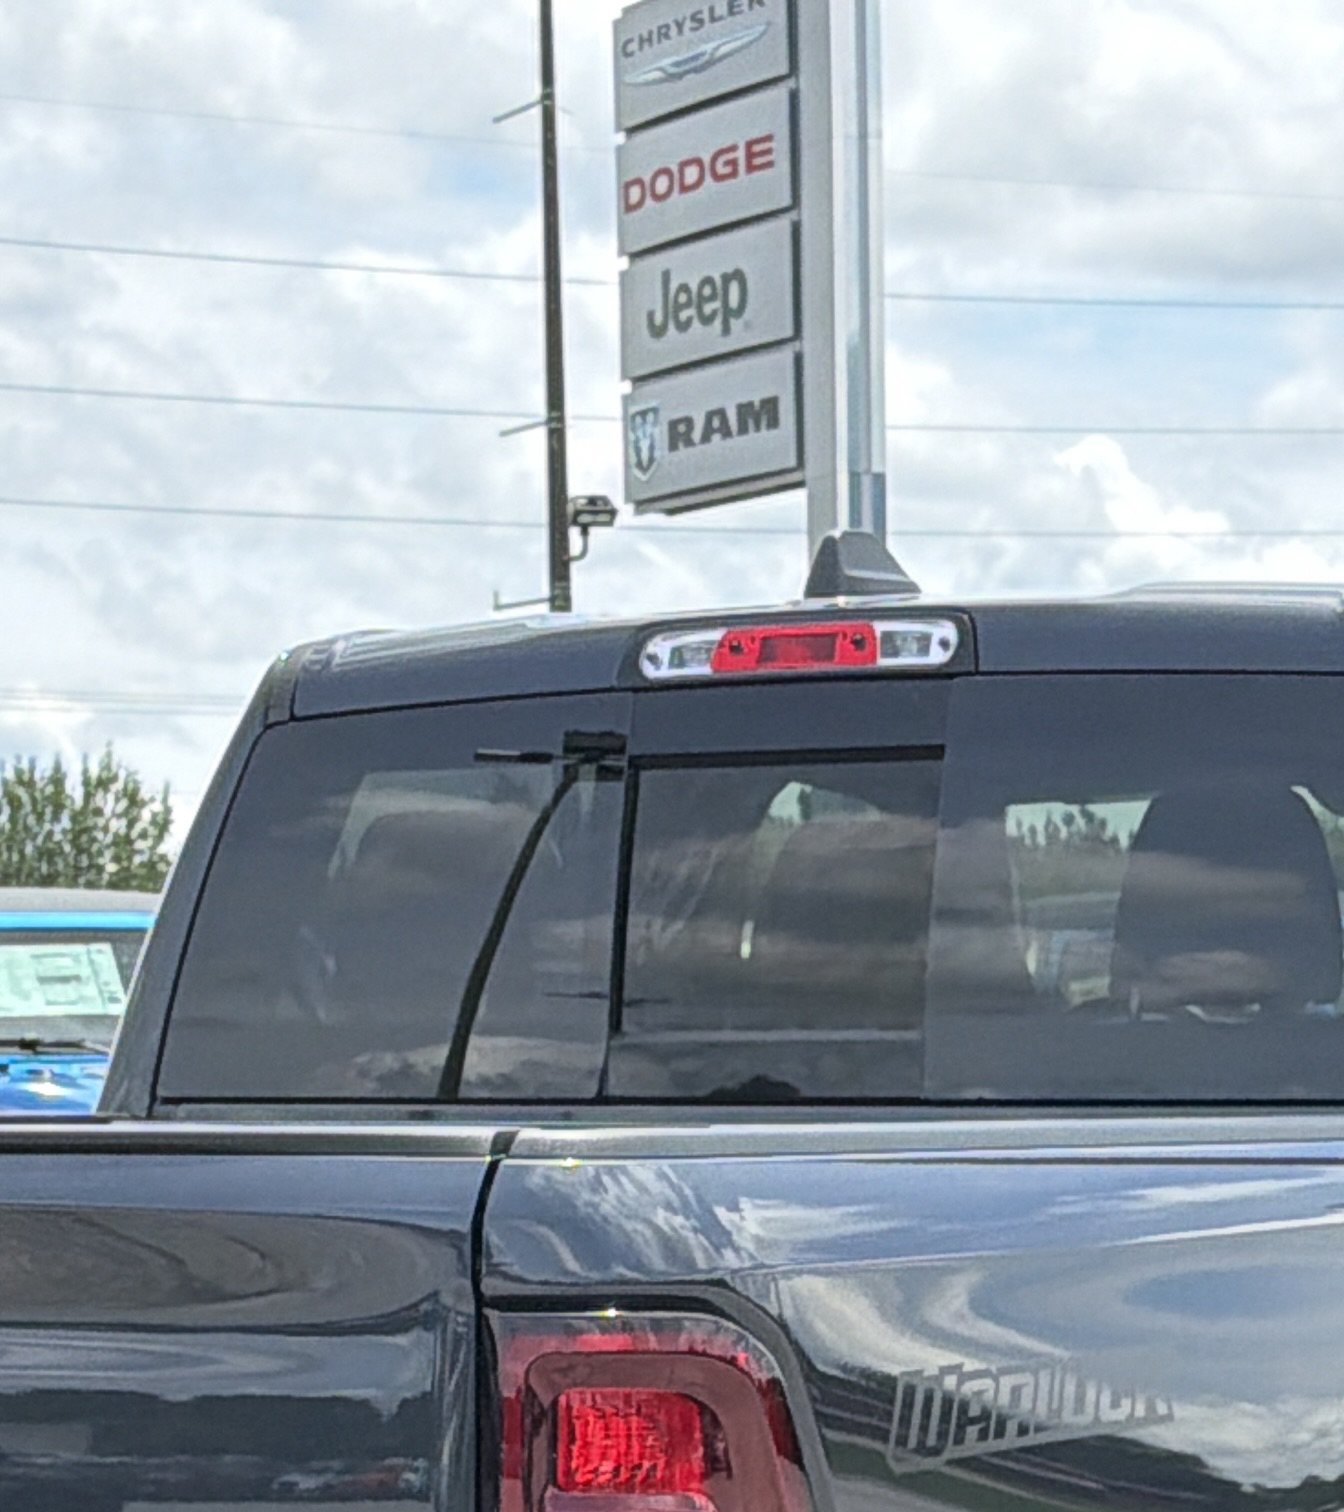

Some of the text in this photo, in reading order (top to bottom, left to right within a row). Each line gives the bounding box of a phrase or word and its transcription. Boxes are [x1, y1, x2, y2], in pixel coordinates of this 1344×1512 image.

[623, 133, 775, 214] DODGE
[646, 267, 748, 339] Jeep
[668, 396, 780, 453] RAM
